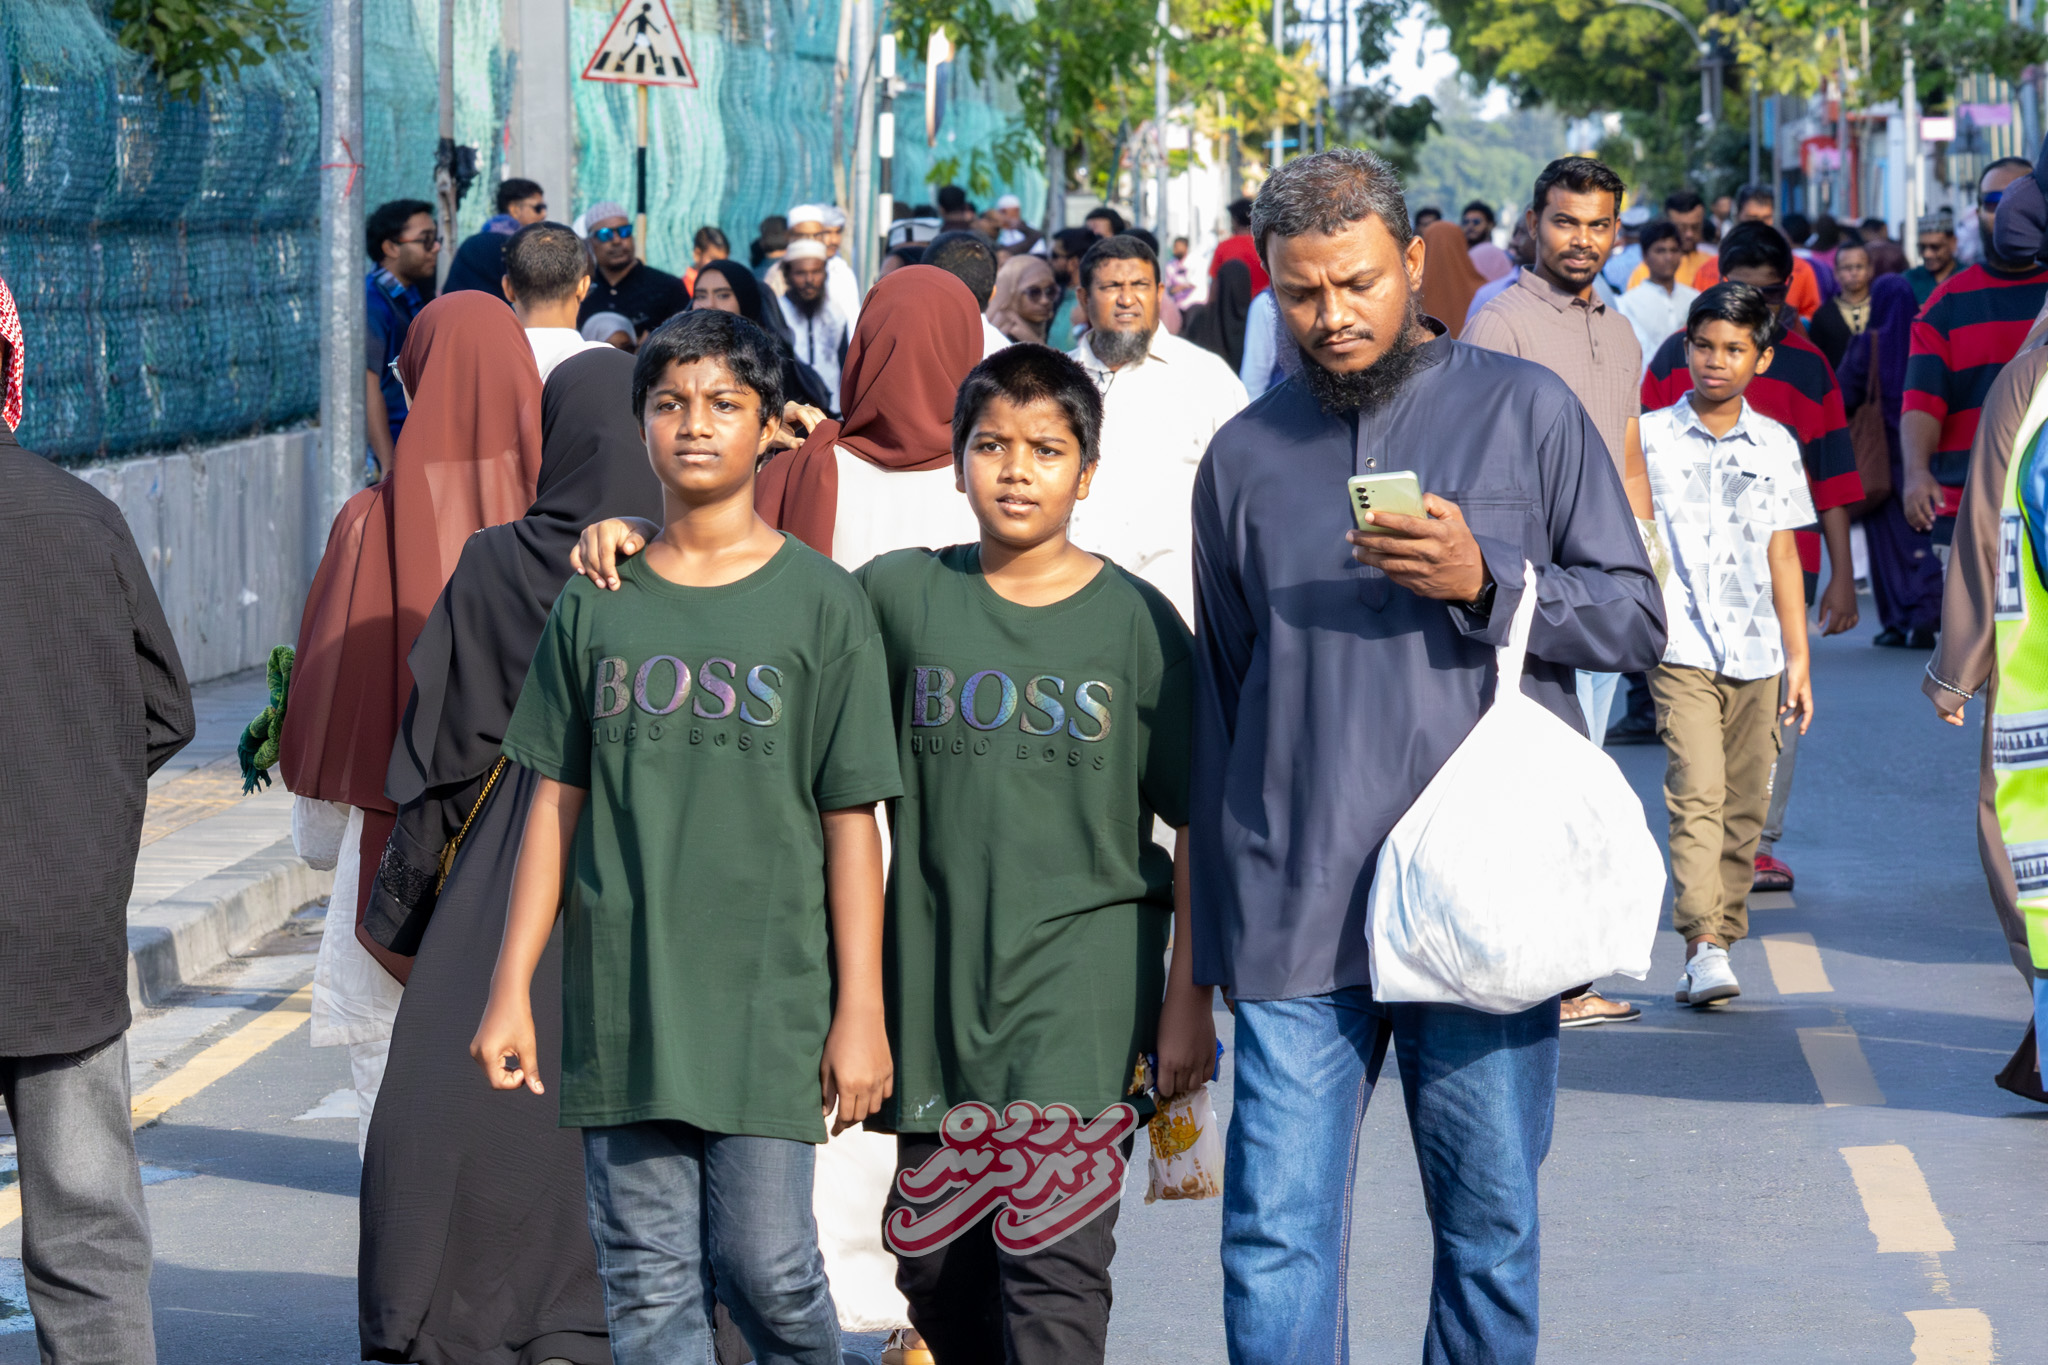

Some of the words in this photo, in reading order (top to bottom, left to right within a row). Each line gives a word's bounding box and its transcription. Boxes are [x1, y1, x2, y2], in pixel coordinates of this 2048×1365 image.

[593, 655, 784, 727] BOSS
[911, 665, 1113, 742] BOSS
[690, 727, 776, 755] BOSS
[911, 735, 991, 756] HUGO
[1016, 743, 1105, 770] BOSS
